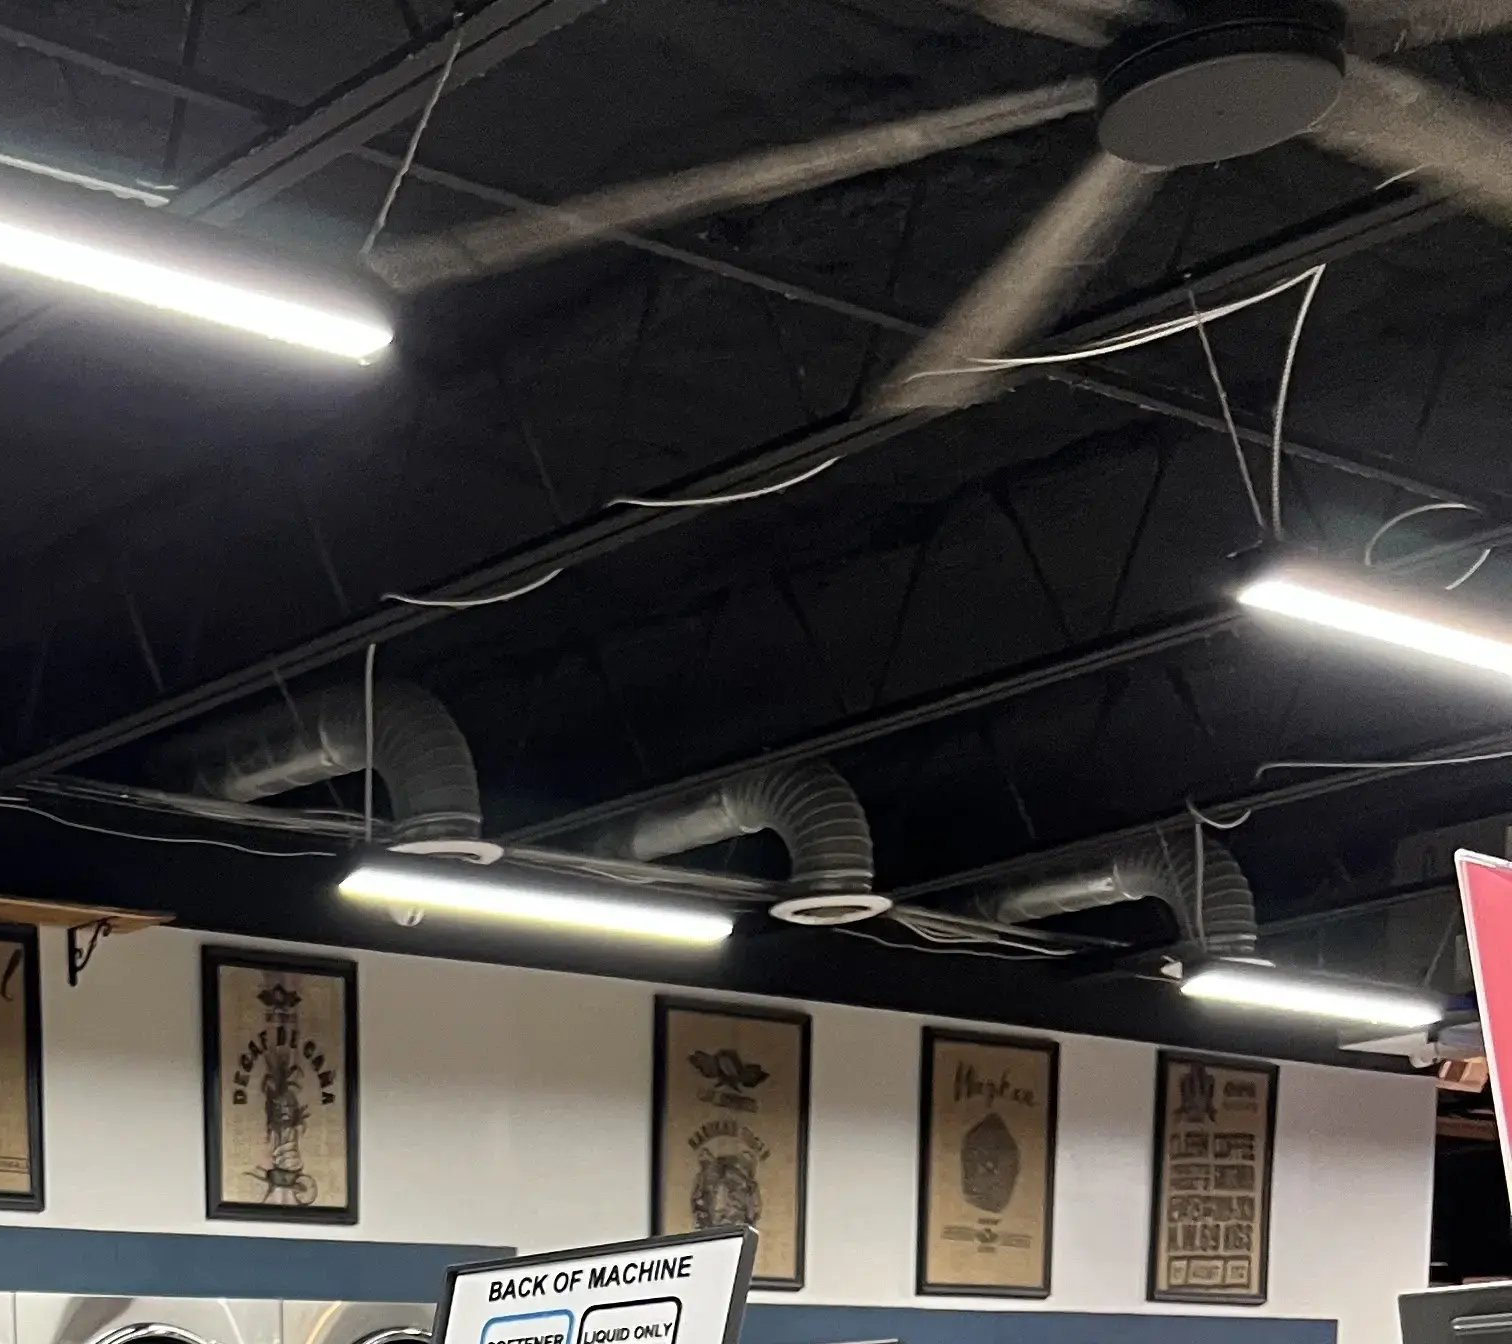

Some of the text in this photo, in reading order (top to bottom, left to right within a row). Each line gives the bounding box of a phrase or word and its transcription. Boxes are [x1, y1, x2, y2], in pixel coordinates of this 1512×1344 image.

[488, 1255, 694, 1302] BACK OF MACHINE
[633, 1322, 673, 1340] ONLY
